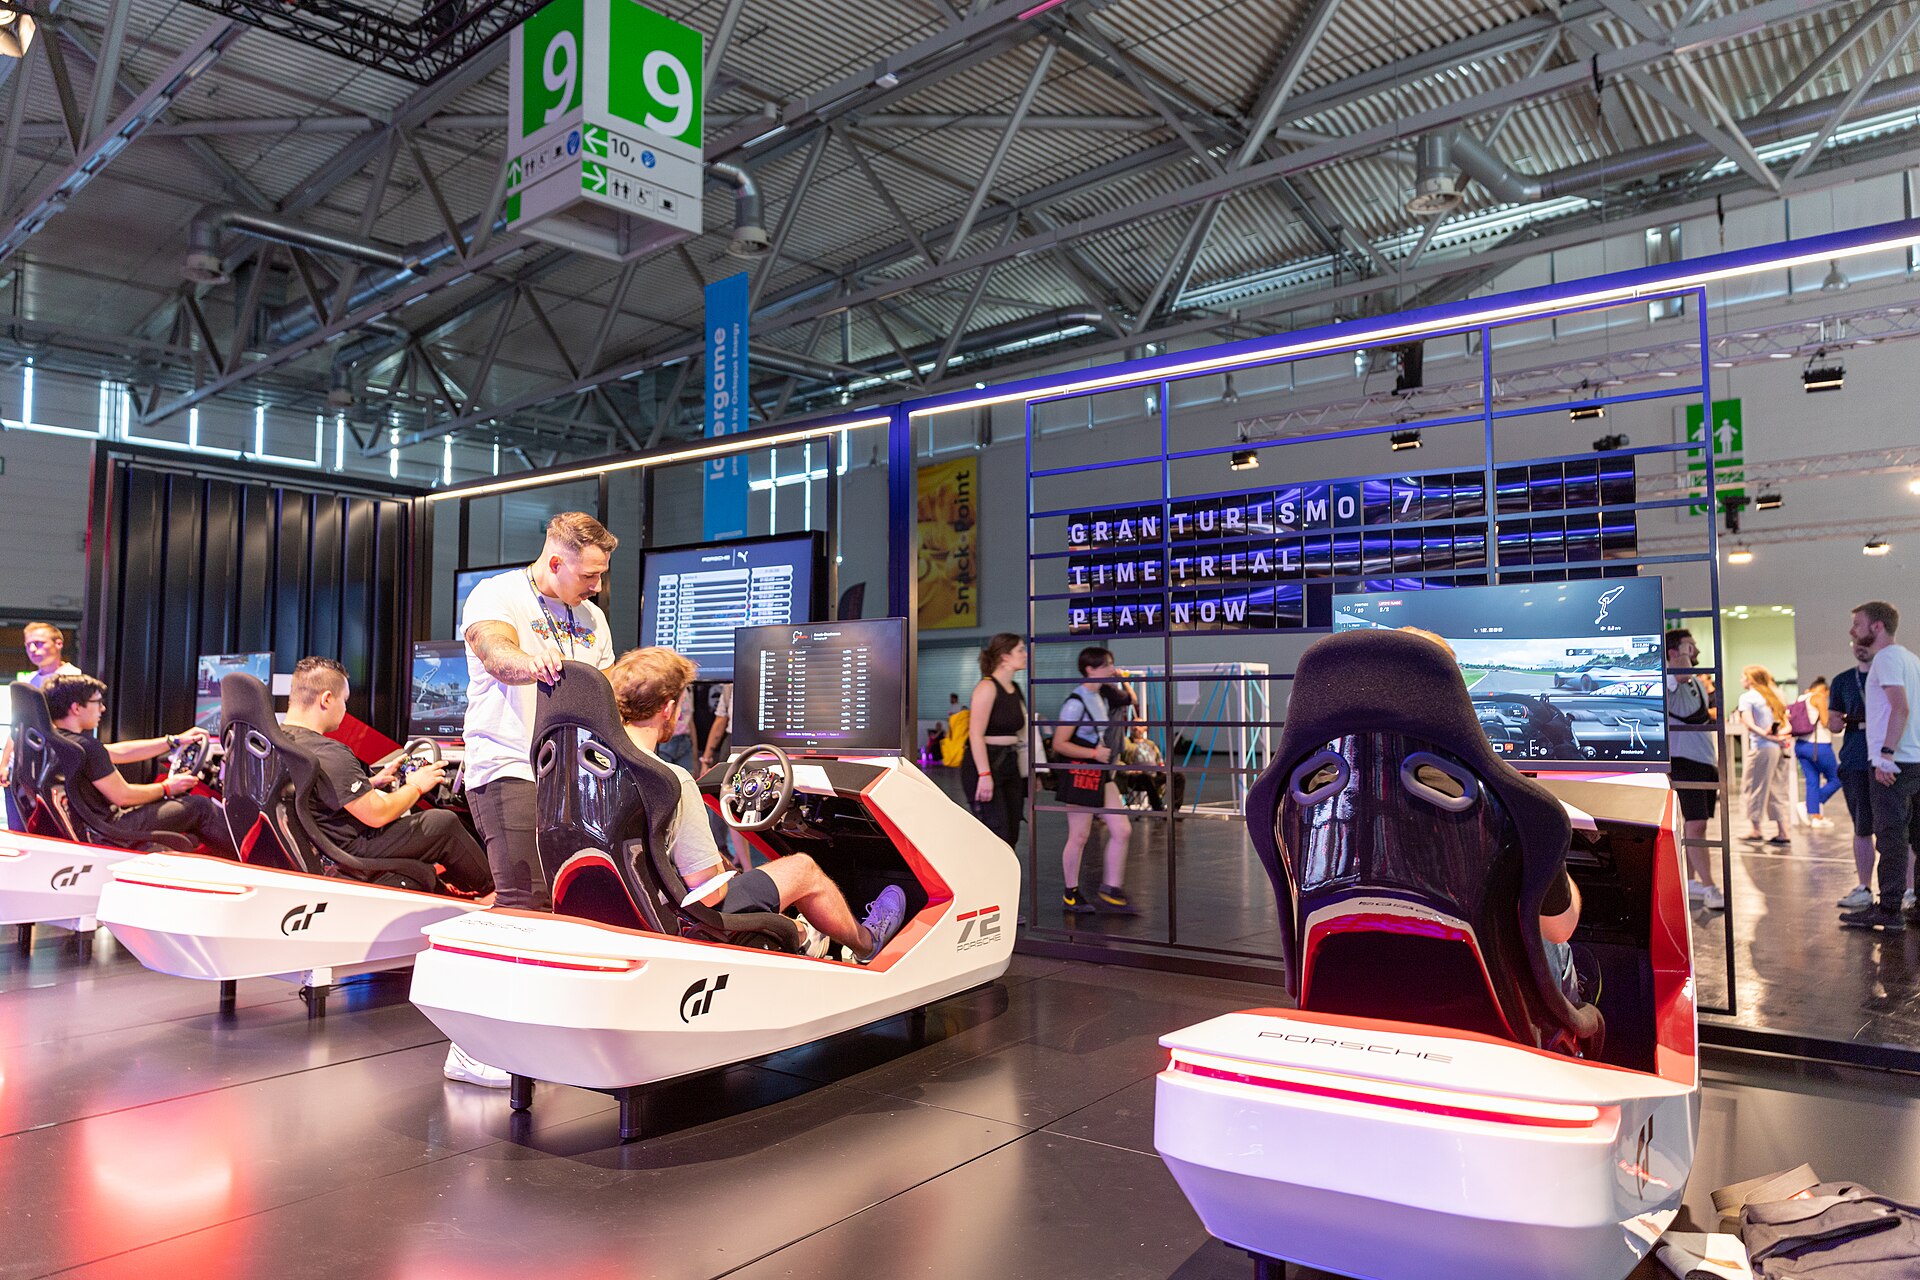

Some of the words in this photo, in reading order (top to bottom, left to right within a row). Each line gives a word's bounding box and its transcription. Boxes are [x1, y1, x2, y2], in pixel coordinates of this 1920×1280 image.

[543, 30, 577, 124] 9
[643, 50, 693, 137] 9
[1071, 516, 1157, 544] GRAN
[1174, 495, 1355, 534] TURISMO
[1399, 491, 1414, 514] 7
[1072, 560, 1156, 585] TIME
[1176, 550, 1296, 579] TRIAL
[1073, 605, 1158, 628] PLAY
[1175, 600, 1247, 624] NOW
[957, 905, 1000, 944] 72
[957, 934, 1001, 952] PORSCHE
[1258, 1031, 1453, 1064] PORSCHE
